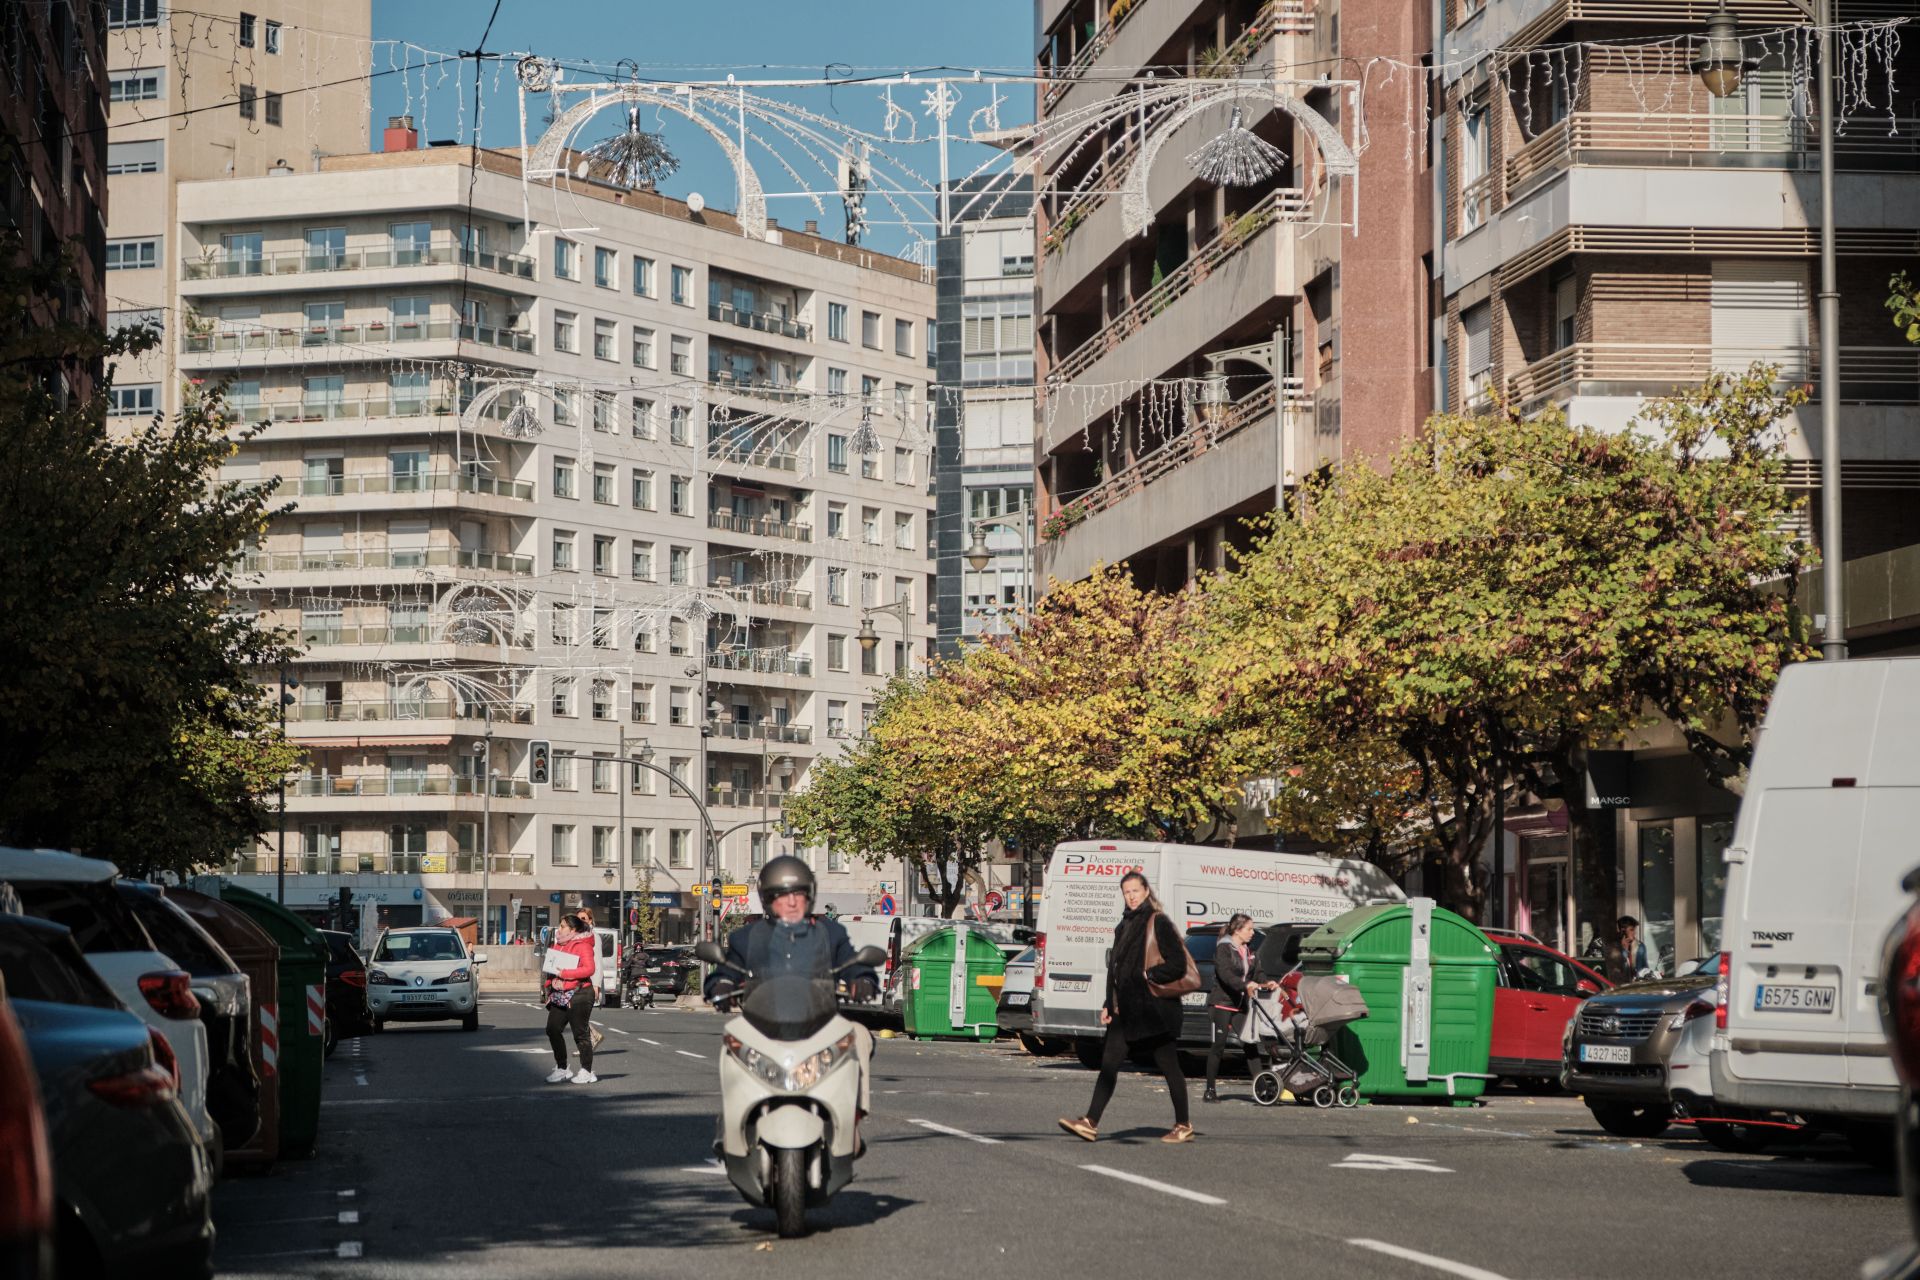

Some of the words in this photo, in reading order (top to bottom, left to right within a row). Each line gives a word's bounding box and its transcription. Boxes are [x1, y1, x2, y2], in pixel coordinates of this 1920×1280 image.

[1089, 854, 1145, 864] Decoraciones
[1294, 899, 1331, 908] INSTALADORES
[1211, 901, 1274, 919] Decoraciones
[1294, 907, 1320, 916] TRABAJOS
[1320, 909, 1328, 917] DE
[1752, 931, 1795, 941] TRANSIT
[1764, 988, 1800, 1006] 6575
[1804, 989, 1832, 1007] GNM
[1587, 1047, 1609, 1060] 4327
[1611, 1048, 1630, 1061] HGB
